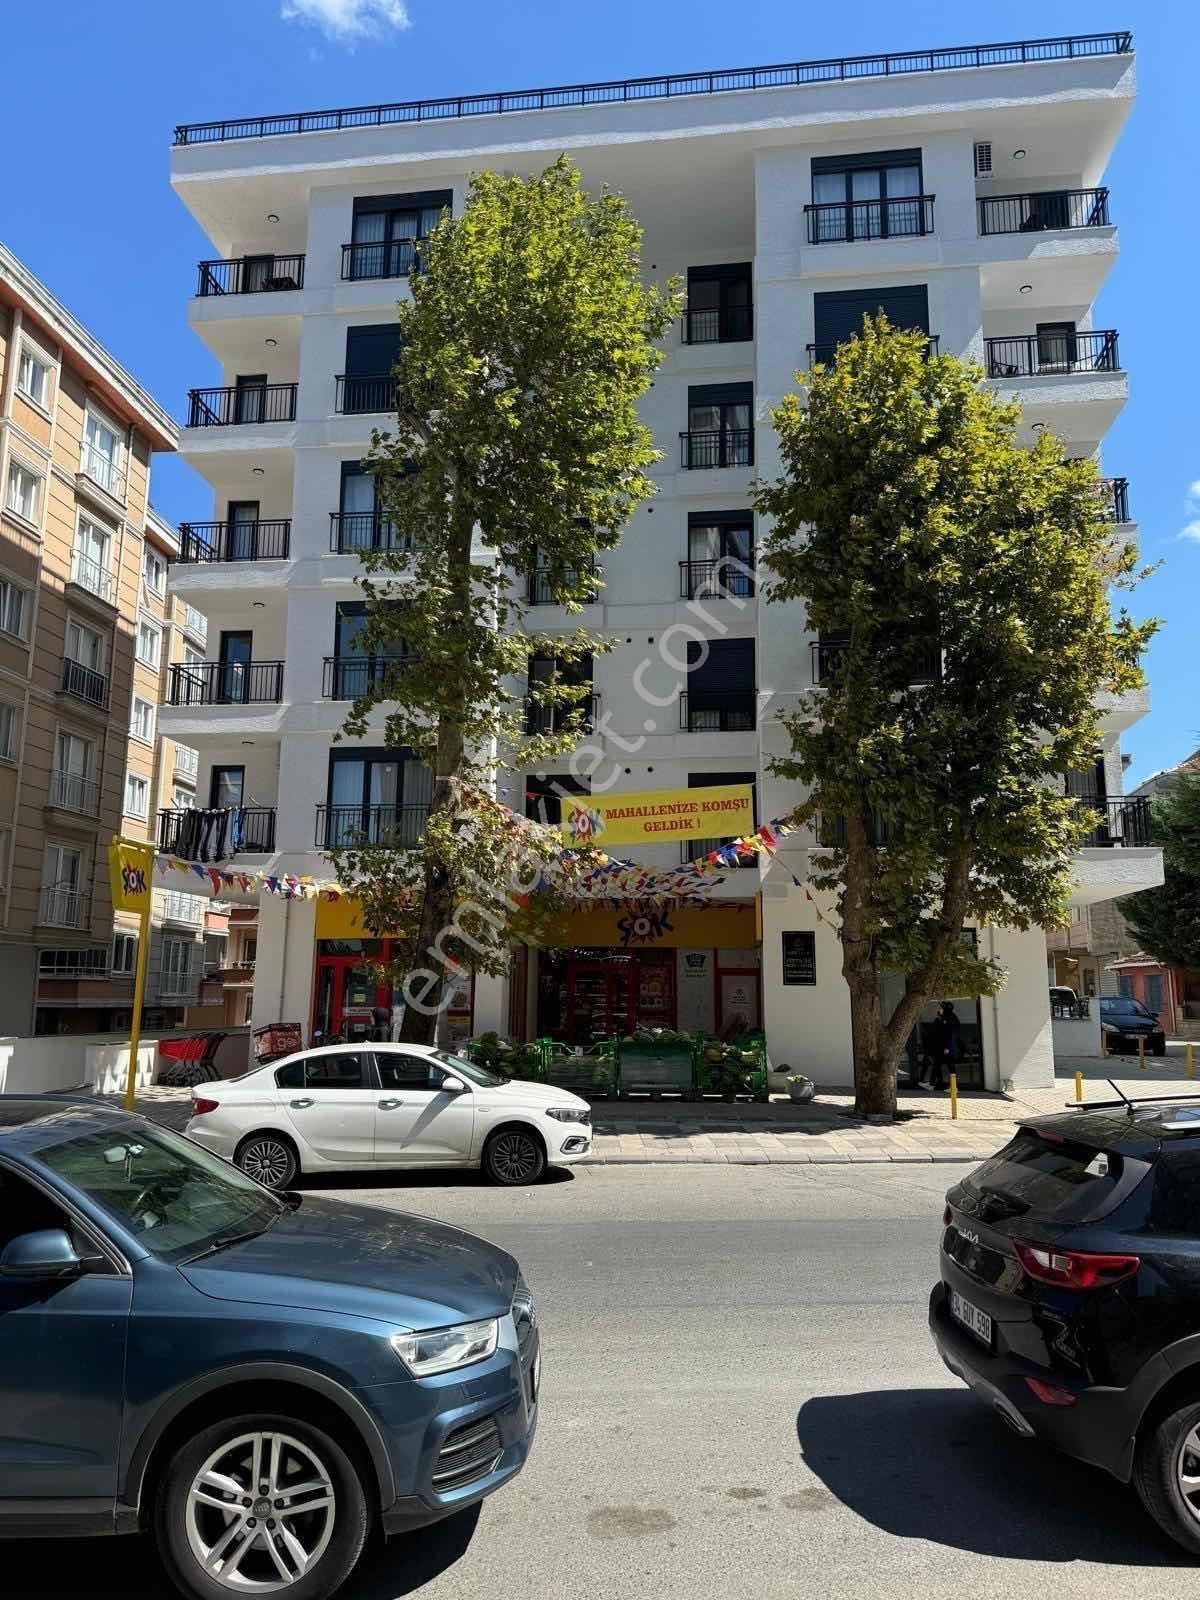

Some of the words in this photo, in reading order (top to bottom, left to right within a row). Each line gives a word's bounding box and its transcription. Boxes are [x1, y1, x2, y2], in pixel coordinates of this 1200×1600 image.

[606, 801, 699, 819] MAHALLENİZE
[702, 798, 749, 812] KOMŞU
[644, 815, 693, 832] GELDİK
